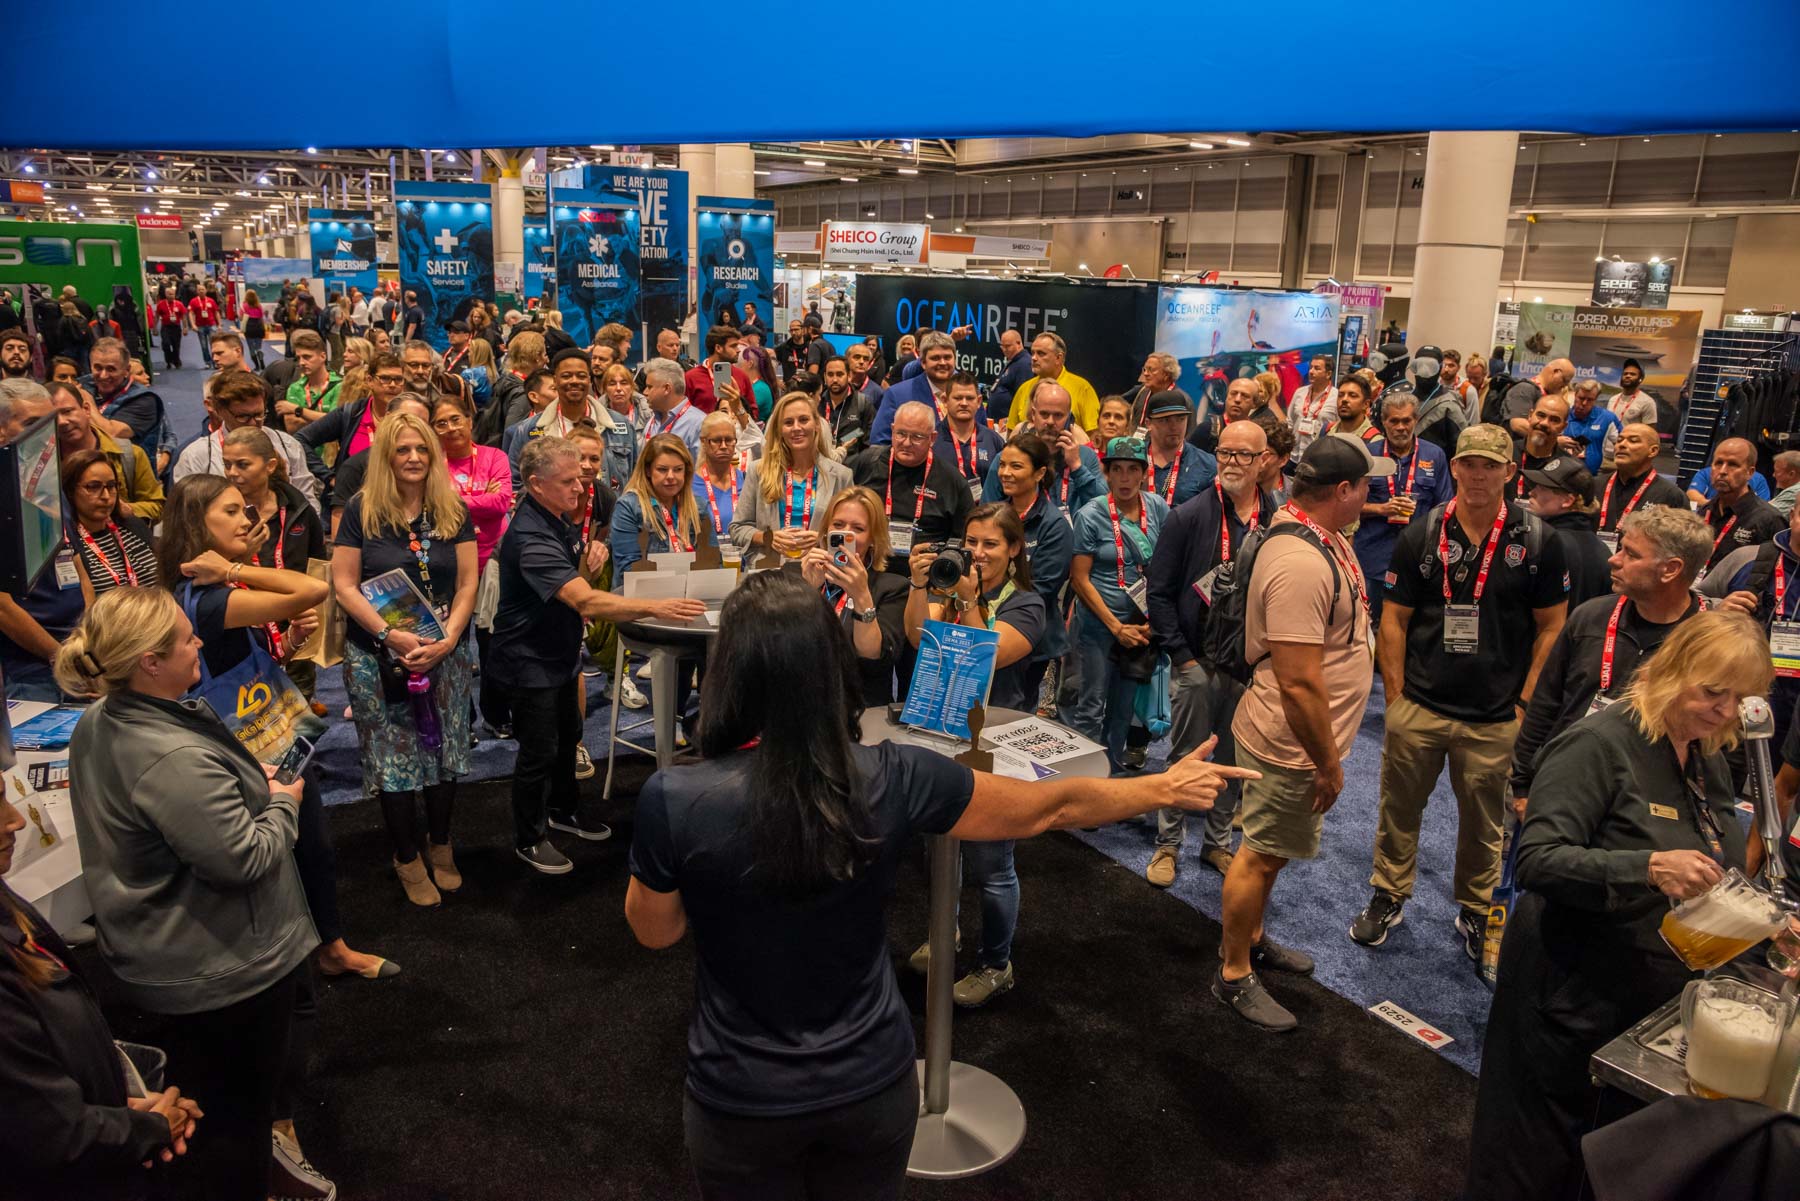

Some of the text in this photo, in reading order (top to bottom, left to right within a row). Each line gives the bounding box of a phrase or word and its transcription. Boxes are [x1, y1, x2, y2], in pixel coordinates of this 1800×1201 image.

[618, 155, 645, 164] LOVE
[614, 176, 668, 189] WE ARE YOUR
[830, 230, 917, 248] SHEICO Group
[320, 258, 369, 270] MEMBERSHIP
[426, 260, 468, 276] SAFETY
[578, 264, 621, 278] MEDICAL
[713, 267, 759, 280] RESEARCH
[432, 278, 465, 286] Services
[581, 280, 618, 288] Assistance
[1600, 280, 1639, 289] seac
[1341, 296, 1370, 305] OWCASE
[1168, 302, 1222, 314] OCEANREEF
[1294, 305, 1333, 318] ARIA
[1613, 315, 1674, 327] VENTURES
[1480, 556, 1492, 575] DAN
[1601, 662, 1612, 682] DAN
[1378, 1005, 1415, 1026] 2529
